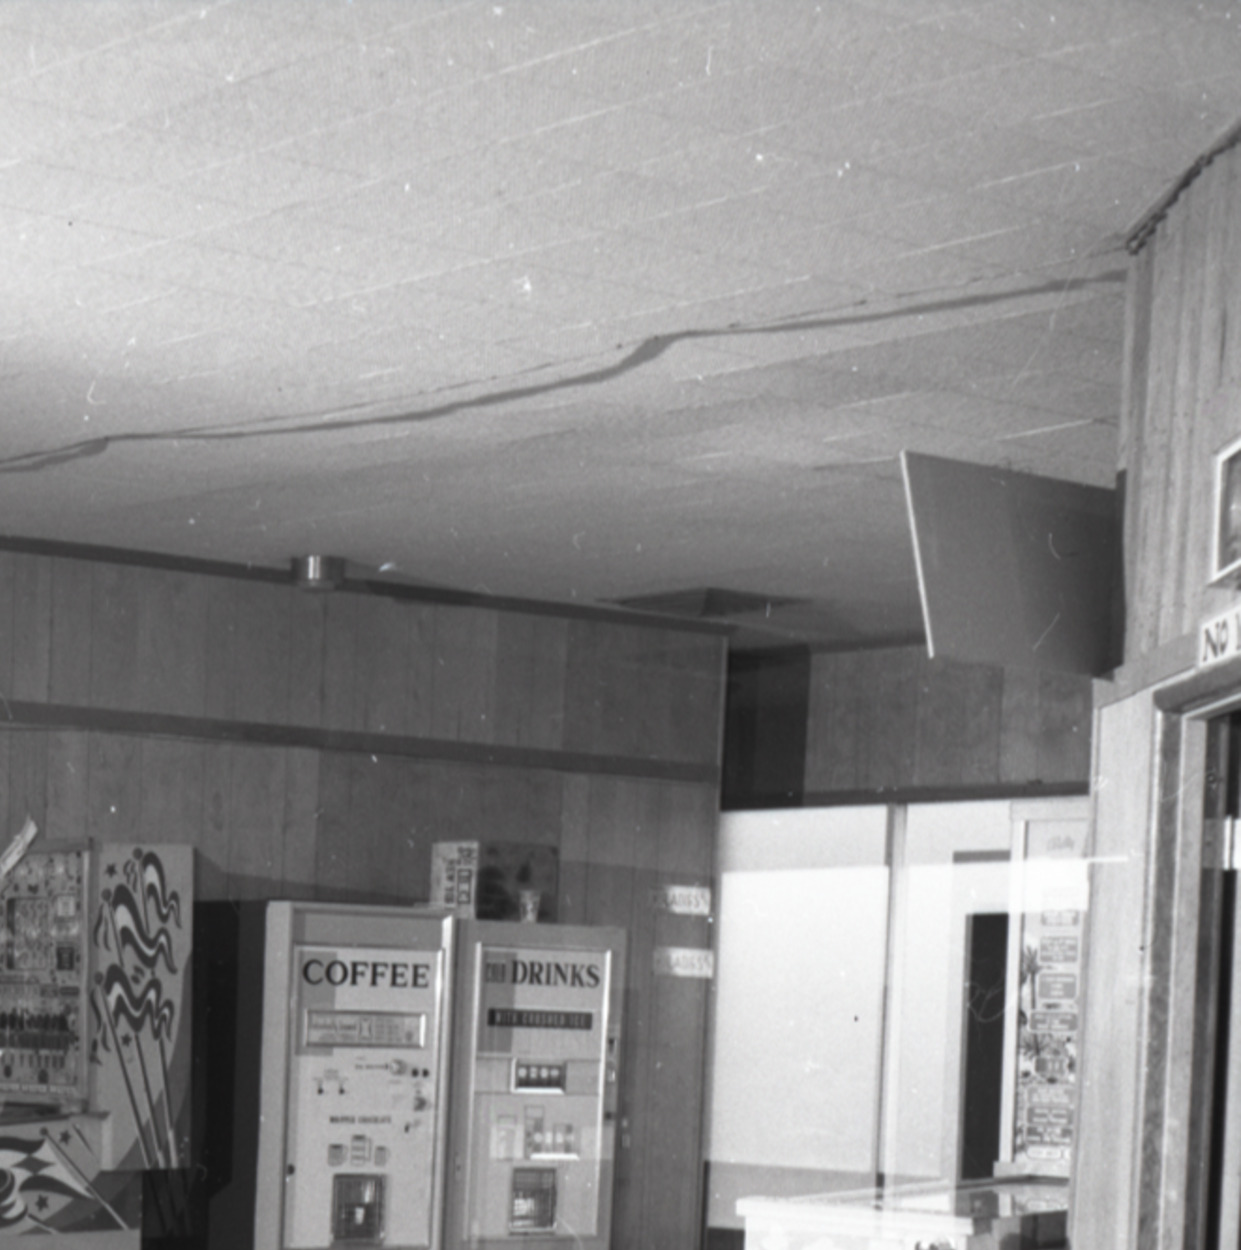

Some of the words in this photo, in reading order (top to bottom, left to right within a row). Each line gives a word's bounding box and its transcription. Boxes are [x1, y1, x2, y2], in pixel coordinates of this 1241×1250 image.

[1202, 619, 1229, 662] NO
[301, 958, 432, 989] COFFEE
[511, 959, 601, 988] DRINKS
